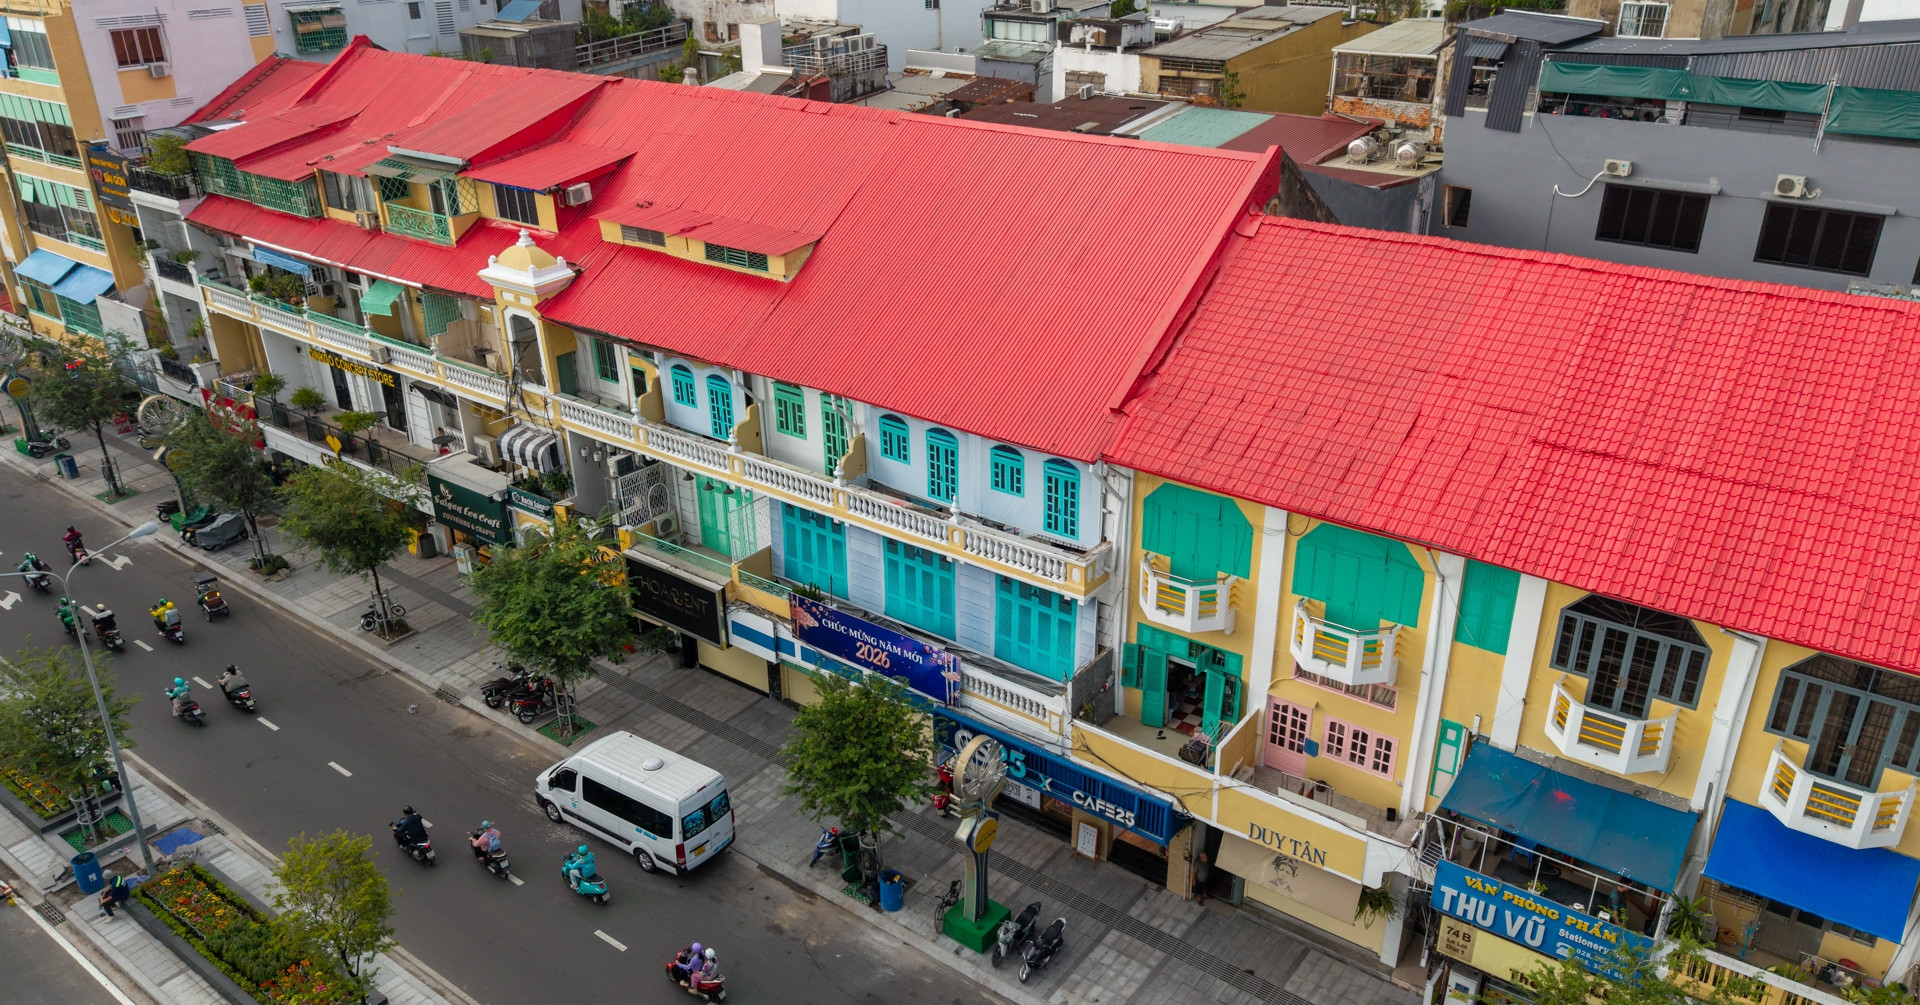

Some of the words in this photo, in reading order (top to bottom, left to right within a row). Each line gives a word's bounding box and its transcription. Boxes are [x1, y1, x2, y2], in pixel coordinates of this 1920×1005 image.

[308, 347, 335, 367] GINKGO
[335, 357, 369, 378] CONCEPT
[369, 369, 395, 388] STORE
[434, 494, 462, 514] Saigon
[463, 506, 479, 520] Eco
[478, 514, 501, 529] Craft
[475, 525, 496, 538] CRAFTS
[822, 618, 848, 635] CHÚC
[848, 628, 878, 646] MỪNG
[879, 639, 902, 656] NĂM
[903, 650, 923, 665] MỚI
[855, 641, 891, 669] 2026
[1072, 790, 1136, 827] CAFE25
[1248, 821, 1287, 850] DUY
[1289, 838, 1327, 867] TÂN
[1464, 875, 1499, 897] VĂN
[1502, 889, 1560, 921] PHÒNG
[1440, 885, 1497, 928] THU
[1504, 910, 1546, 948] VŨ
[1445, 943, 1460, 954] Dist
[1446, 937, 1456, 945] Le
[1457, 941, 1467, 950] Loi
[1558, 928, 1610, 955] Stationery
